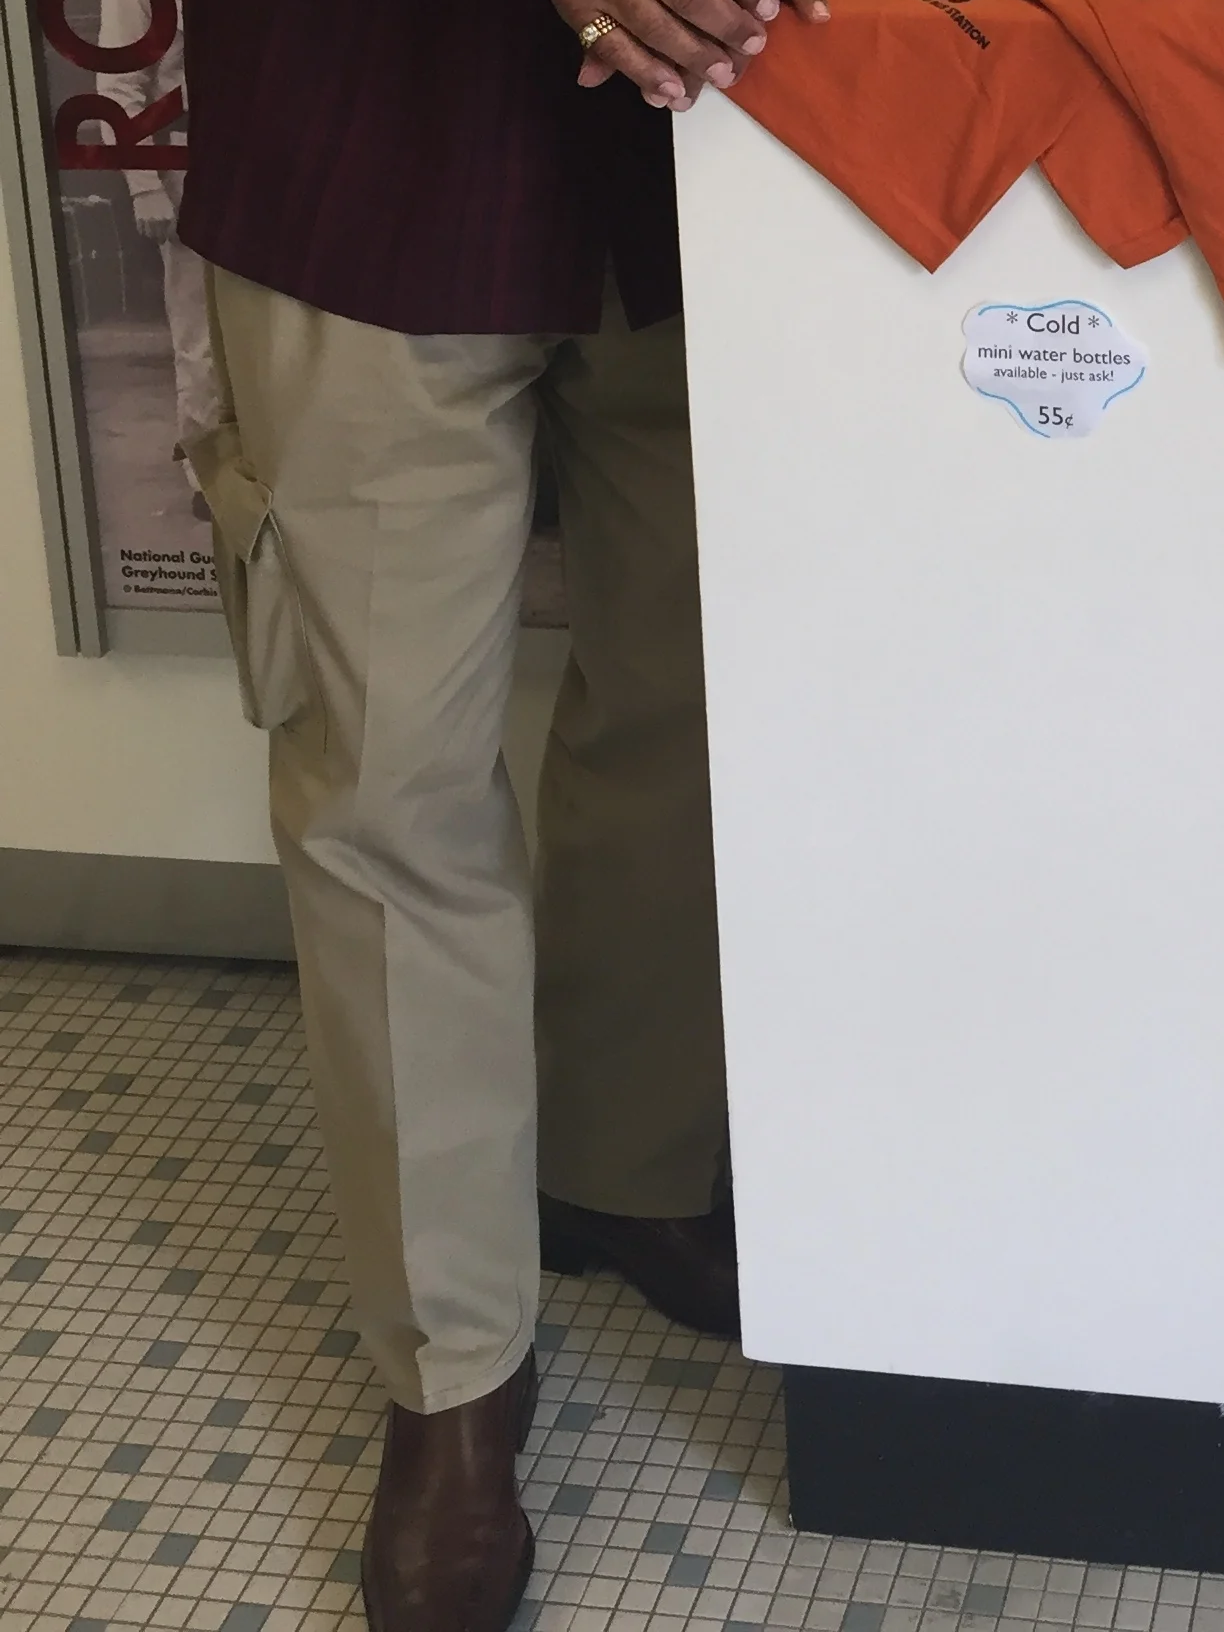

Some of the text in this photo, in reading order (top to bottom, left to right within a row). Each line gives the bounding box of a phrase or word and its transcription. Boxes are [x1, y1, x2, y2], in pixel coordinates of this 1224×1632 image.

[945, 6, 991, 50] STATION
[1027, 312, 1080, 334] Cold
[978, 344, 1131, 365] mini water bottles
[994, 367, 1114, 383] available just ask!
[1038, 406, 1074, 429] 55¢
[120, 549, 185, 564] National
[122, 565, 205, 582] Greyhound
